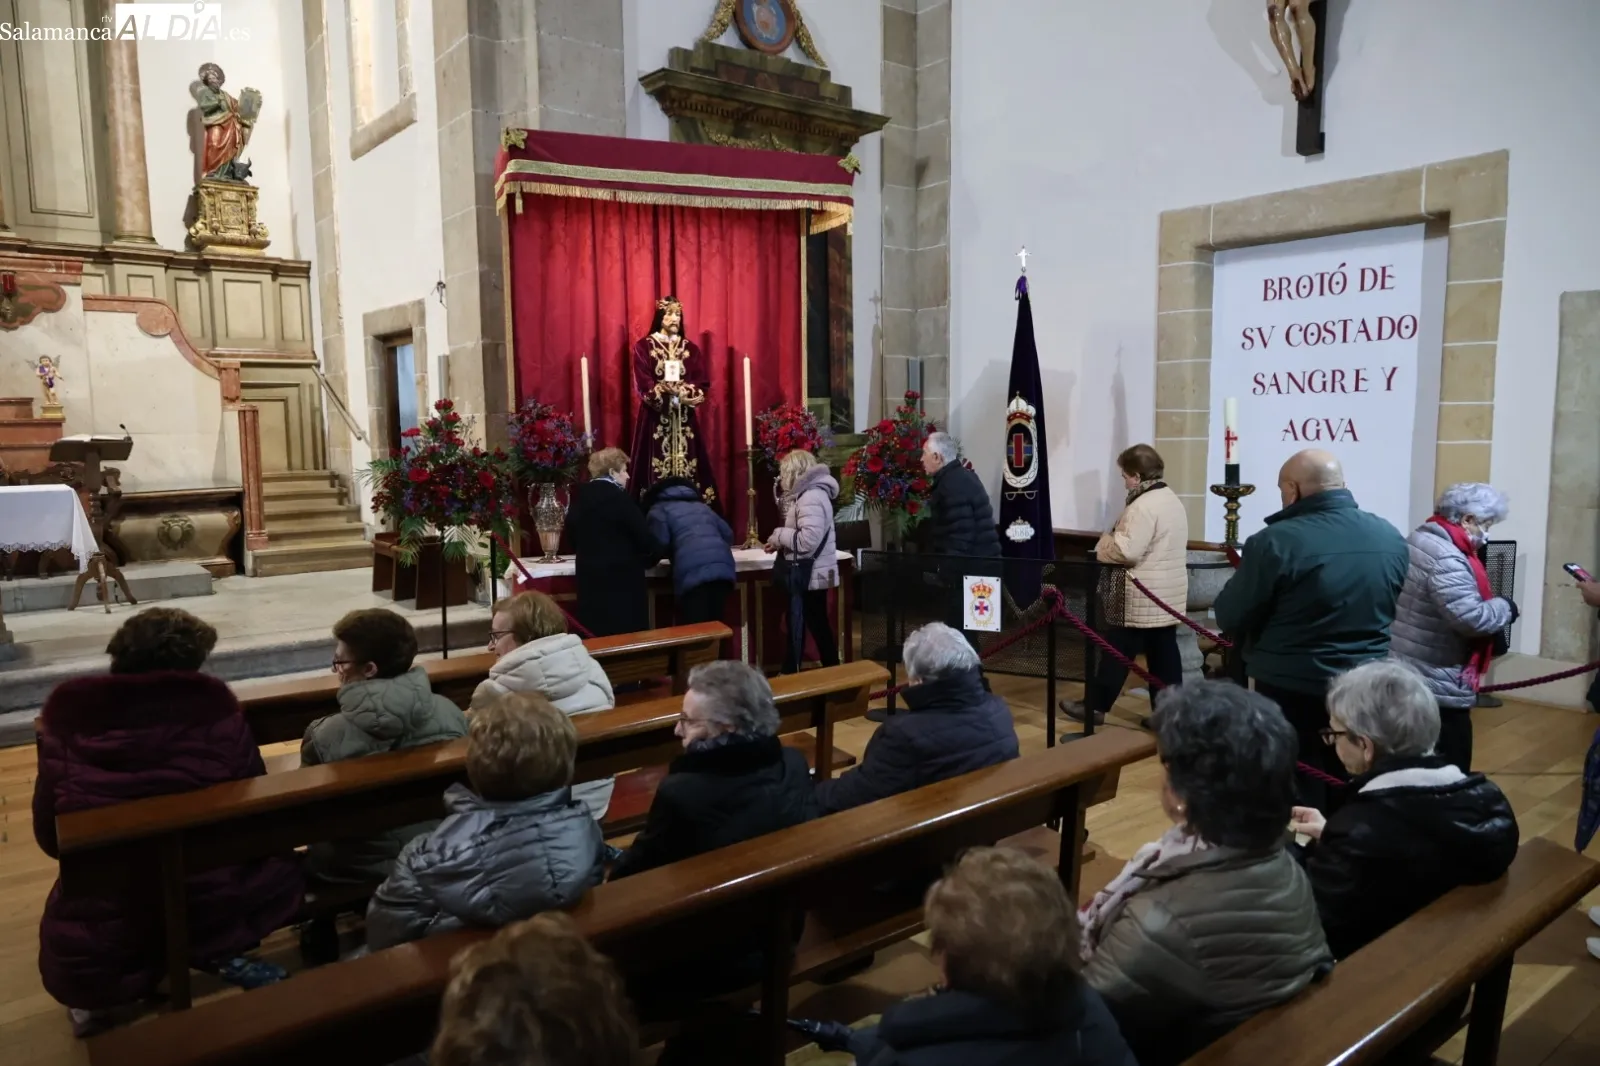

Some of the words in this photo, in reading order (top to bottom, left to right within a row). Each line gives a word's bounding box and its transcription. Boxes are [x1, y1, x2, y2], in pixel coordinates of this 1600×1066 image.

[1263, 262, 1347, 301] BROTÓ
[1359, 264, 1396, 292] DE
[1241, 325, 1275, 350] SV
[1285, 314, 1418, 347] COSTADO
[1252, 367, 1369, 396] SANGRE
[1381, 366, 1399, 391] Y
[1281, 417, 1360, 441] AGVA
